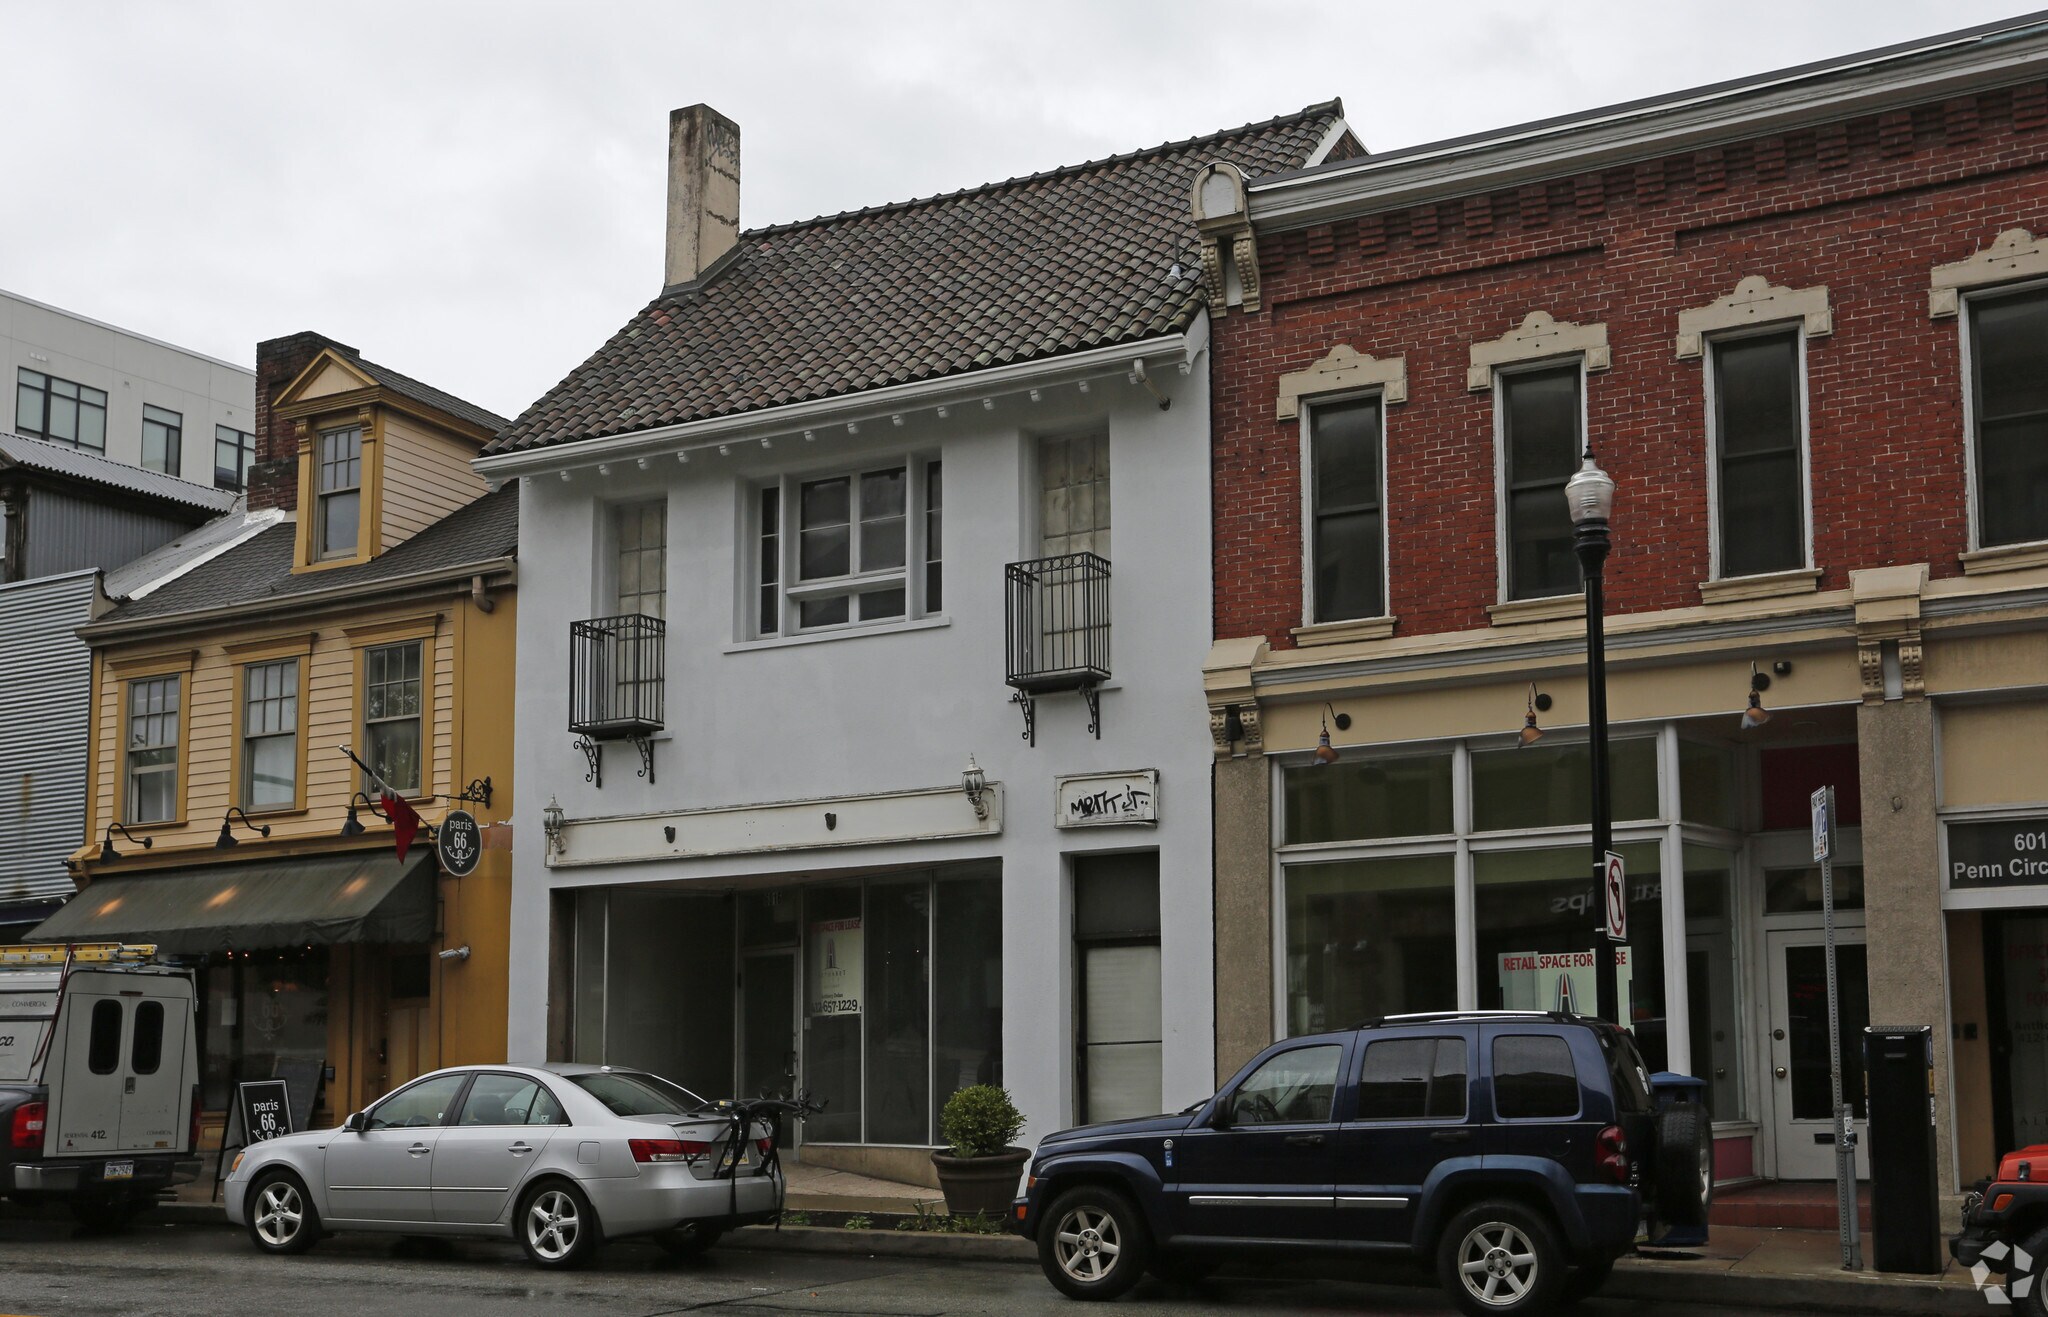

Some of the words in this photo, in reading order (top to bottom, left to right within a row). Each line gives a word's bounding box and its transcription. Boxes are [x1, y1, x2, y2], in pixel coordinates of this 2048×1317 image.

[449, 819, 473, 831] paris
[454, 832, 467, 849] 66
[2014, 832, 2047, 851] 601
[1953, 862, 2003, 880] Penn
[1503, 957, 1537, 971] RETAIL
[1539, 954, 1571, 969] SPACE
[1573, 953, 1594, 968] FOR
[253, 1098, 279, 1115] paris
[260, 1113, 276, 1131] 66
